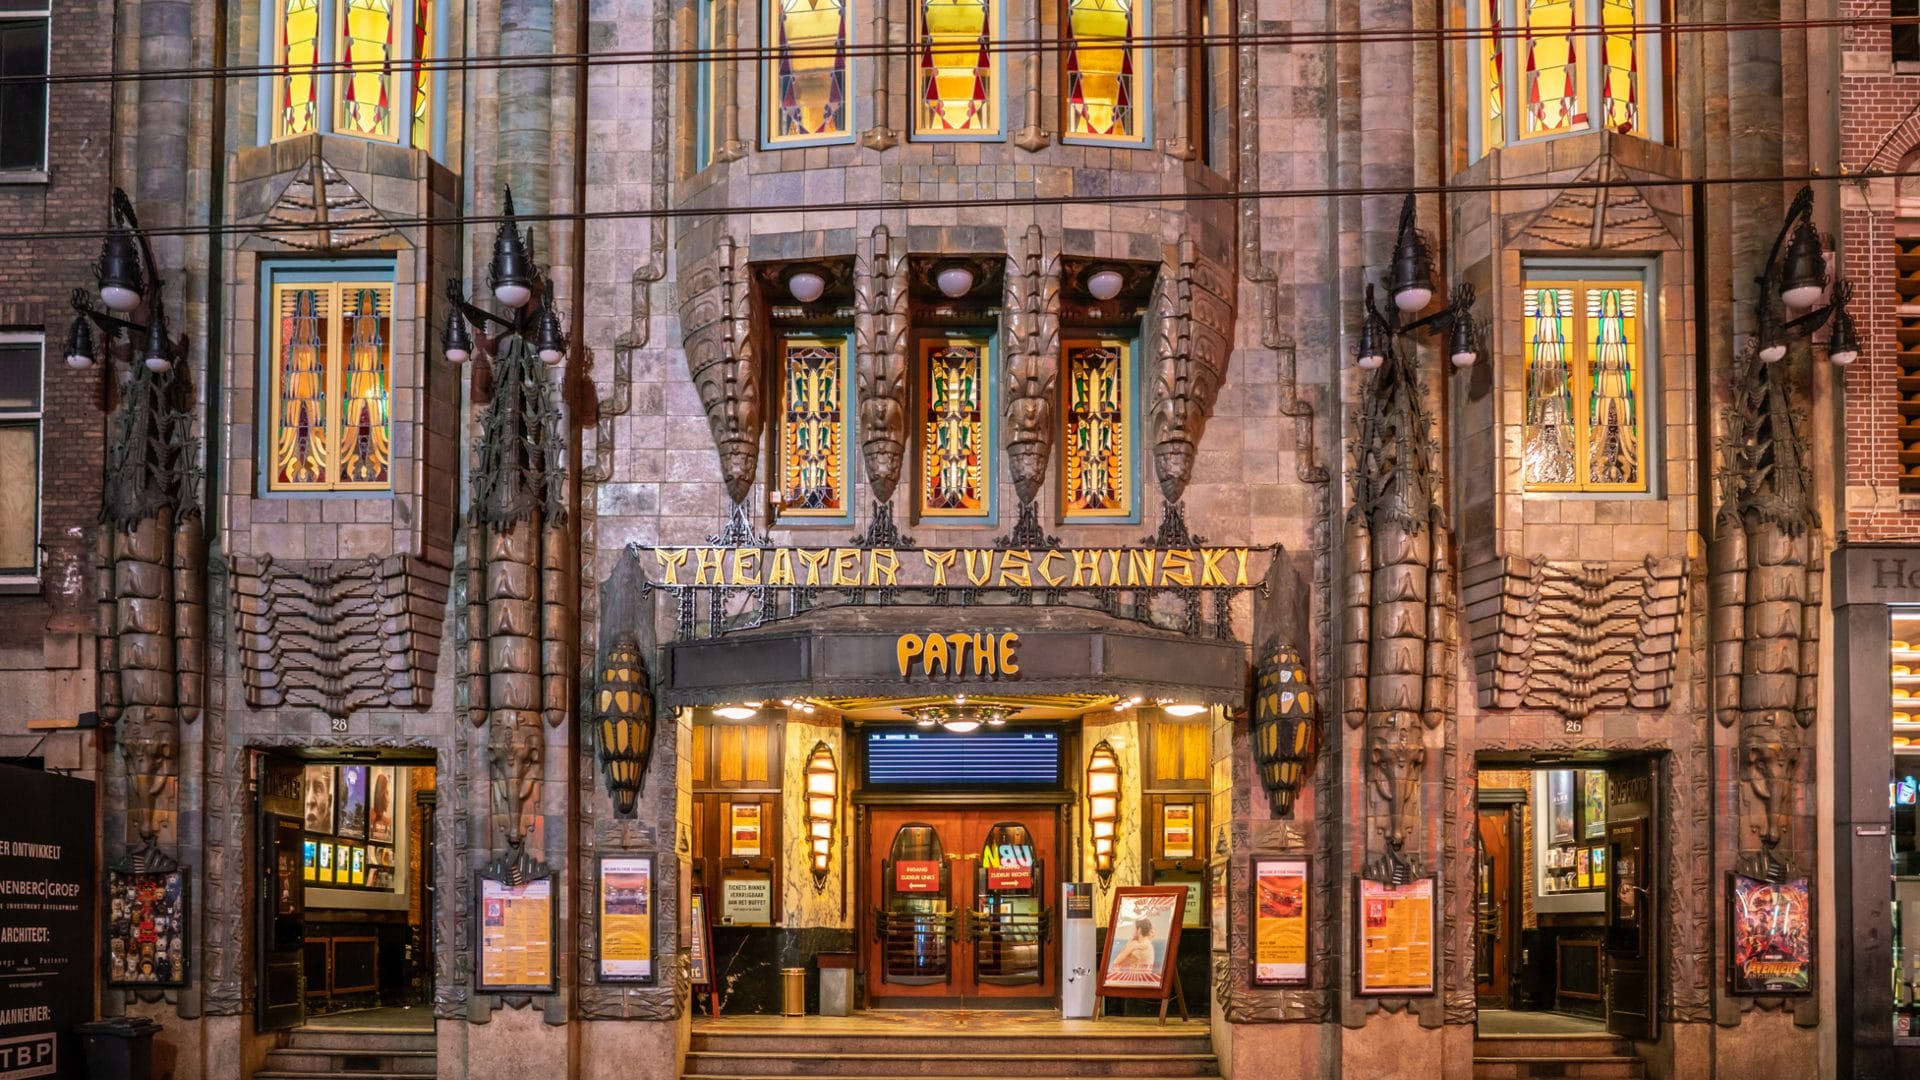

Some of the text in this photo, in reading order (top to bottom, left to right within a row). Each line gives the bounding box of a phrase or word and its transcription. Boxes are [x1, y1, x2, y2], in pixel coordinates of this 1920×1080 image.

[655, 548, 1250, 586] THEATER TUSCHINSKI
[897, 632, 1020, 676] PATHE
[332, 718, 347, 731] 28
[1566, 720, 1582, 732] 26
[12, 842, 61, 860] ONTWIKKELT
[1, 927, 50, 943] ARCHITECT:
